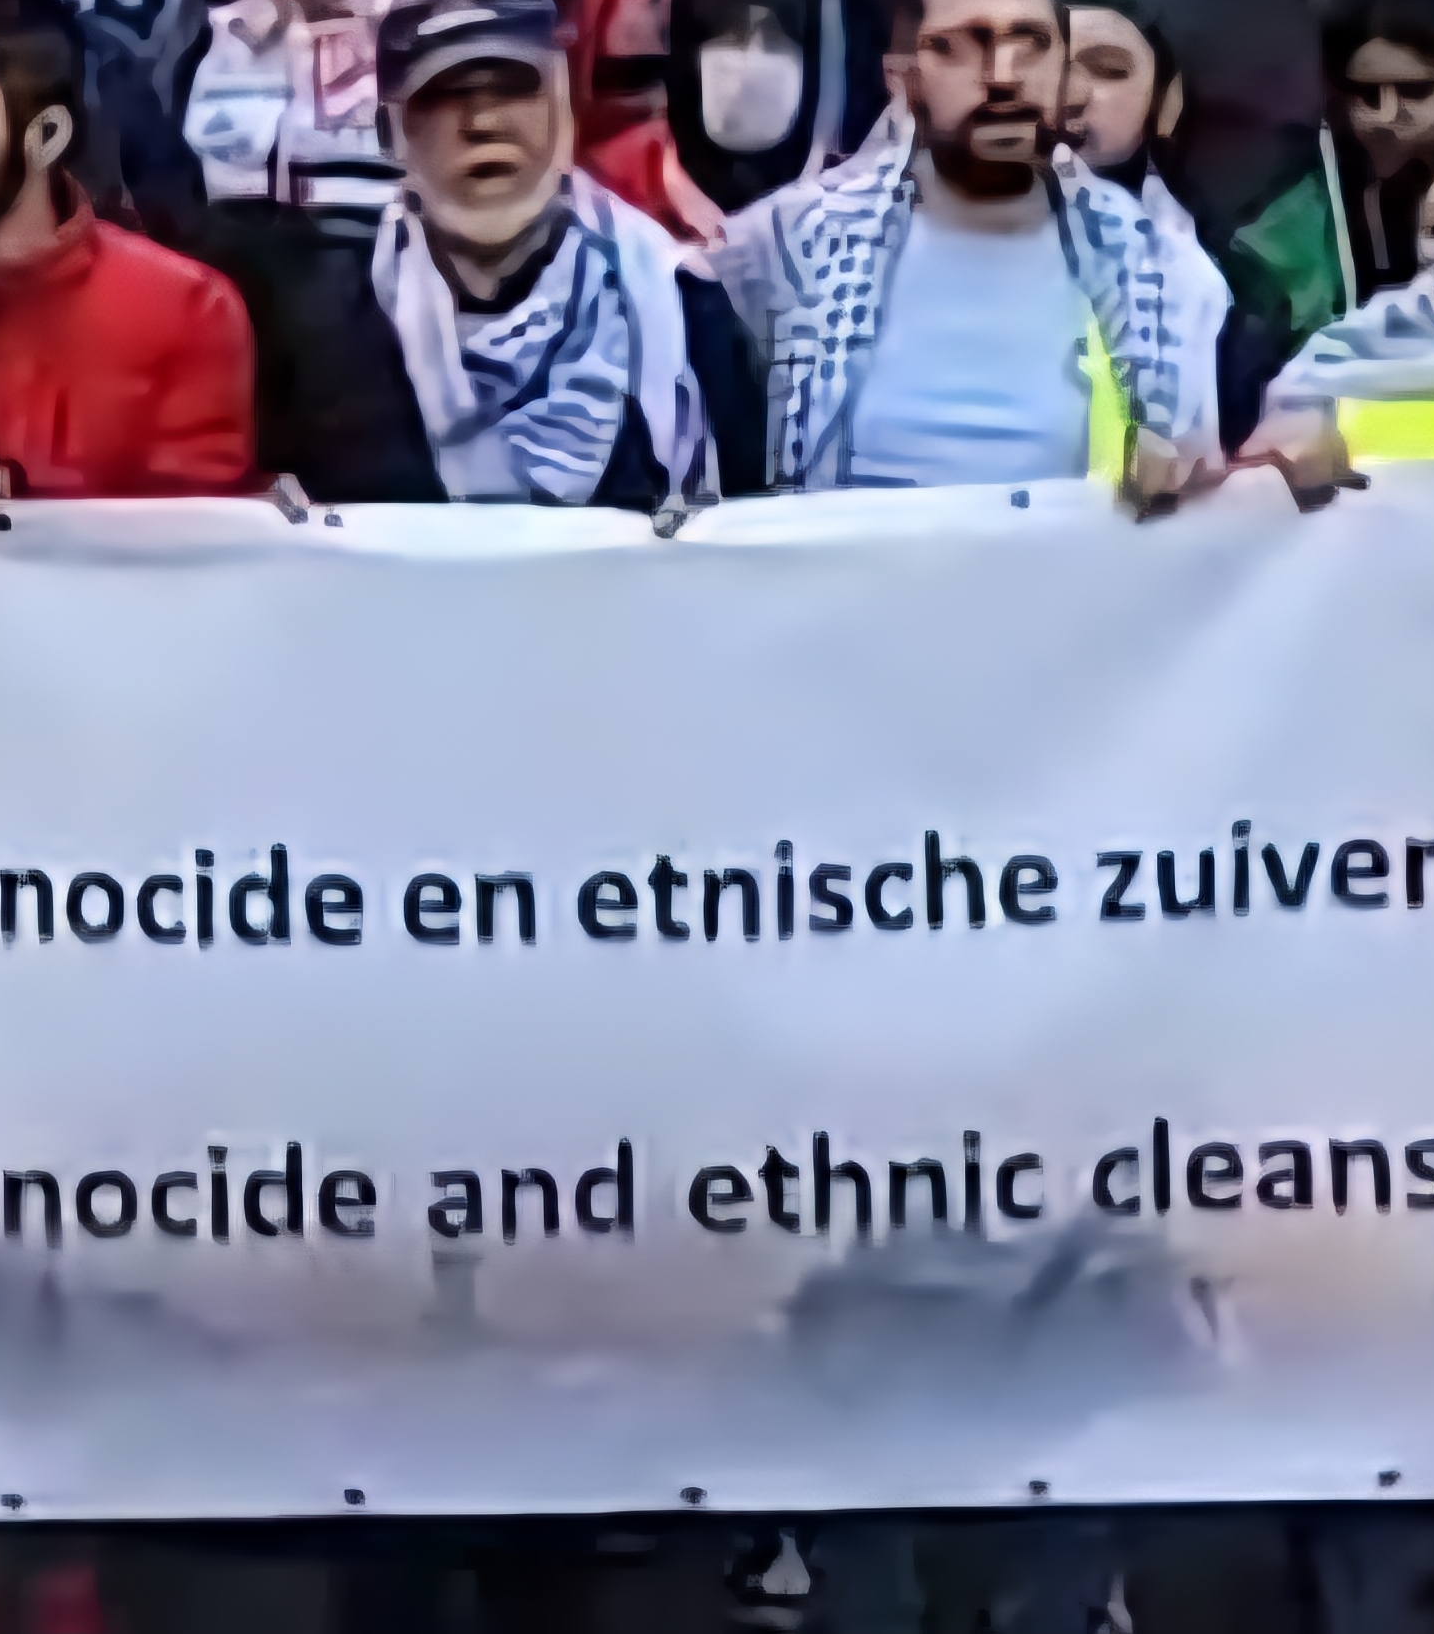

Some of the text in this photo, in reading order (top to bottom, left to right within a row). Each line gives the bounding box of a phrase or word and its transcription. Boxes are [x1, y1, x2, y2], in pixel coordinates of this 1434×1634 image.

[404, 873, 536, 944] en
[578, 831, 1059, 941] etnische
[428, 1139, 634, 1246] and
[689, 1130, 1042, 1236] ethnic
